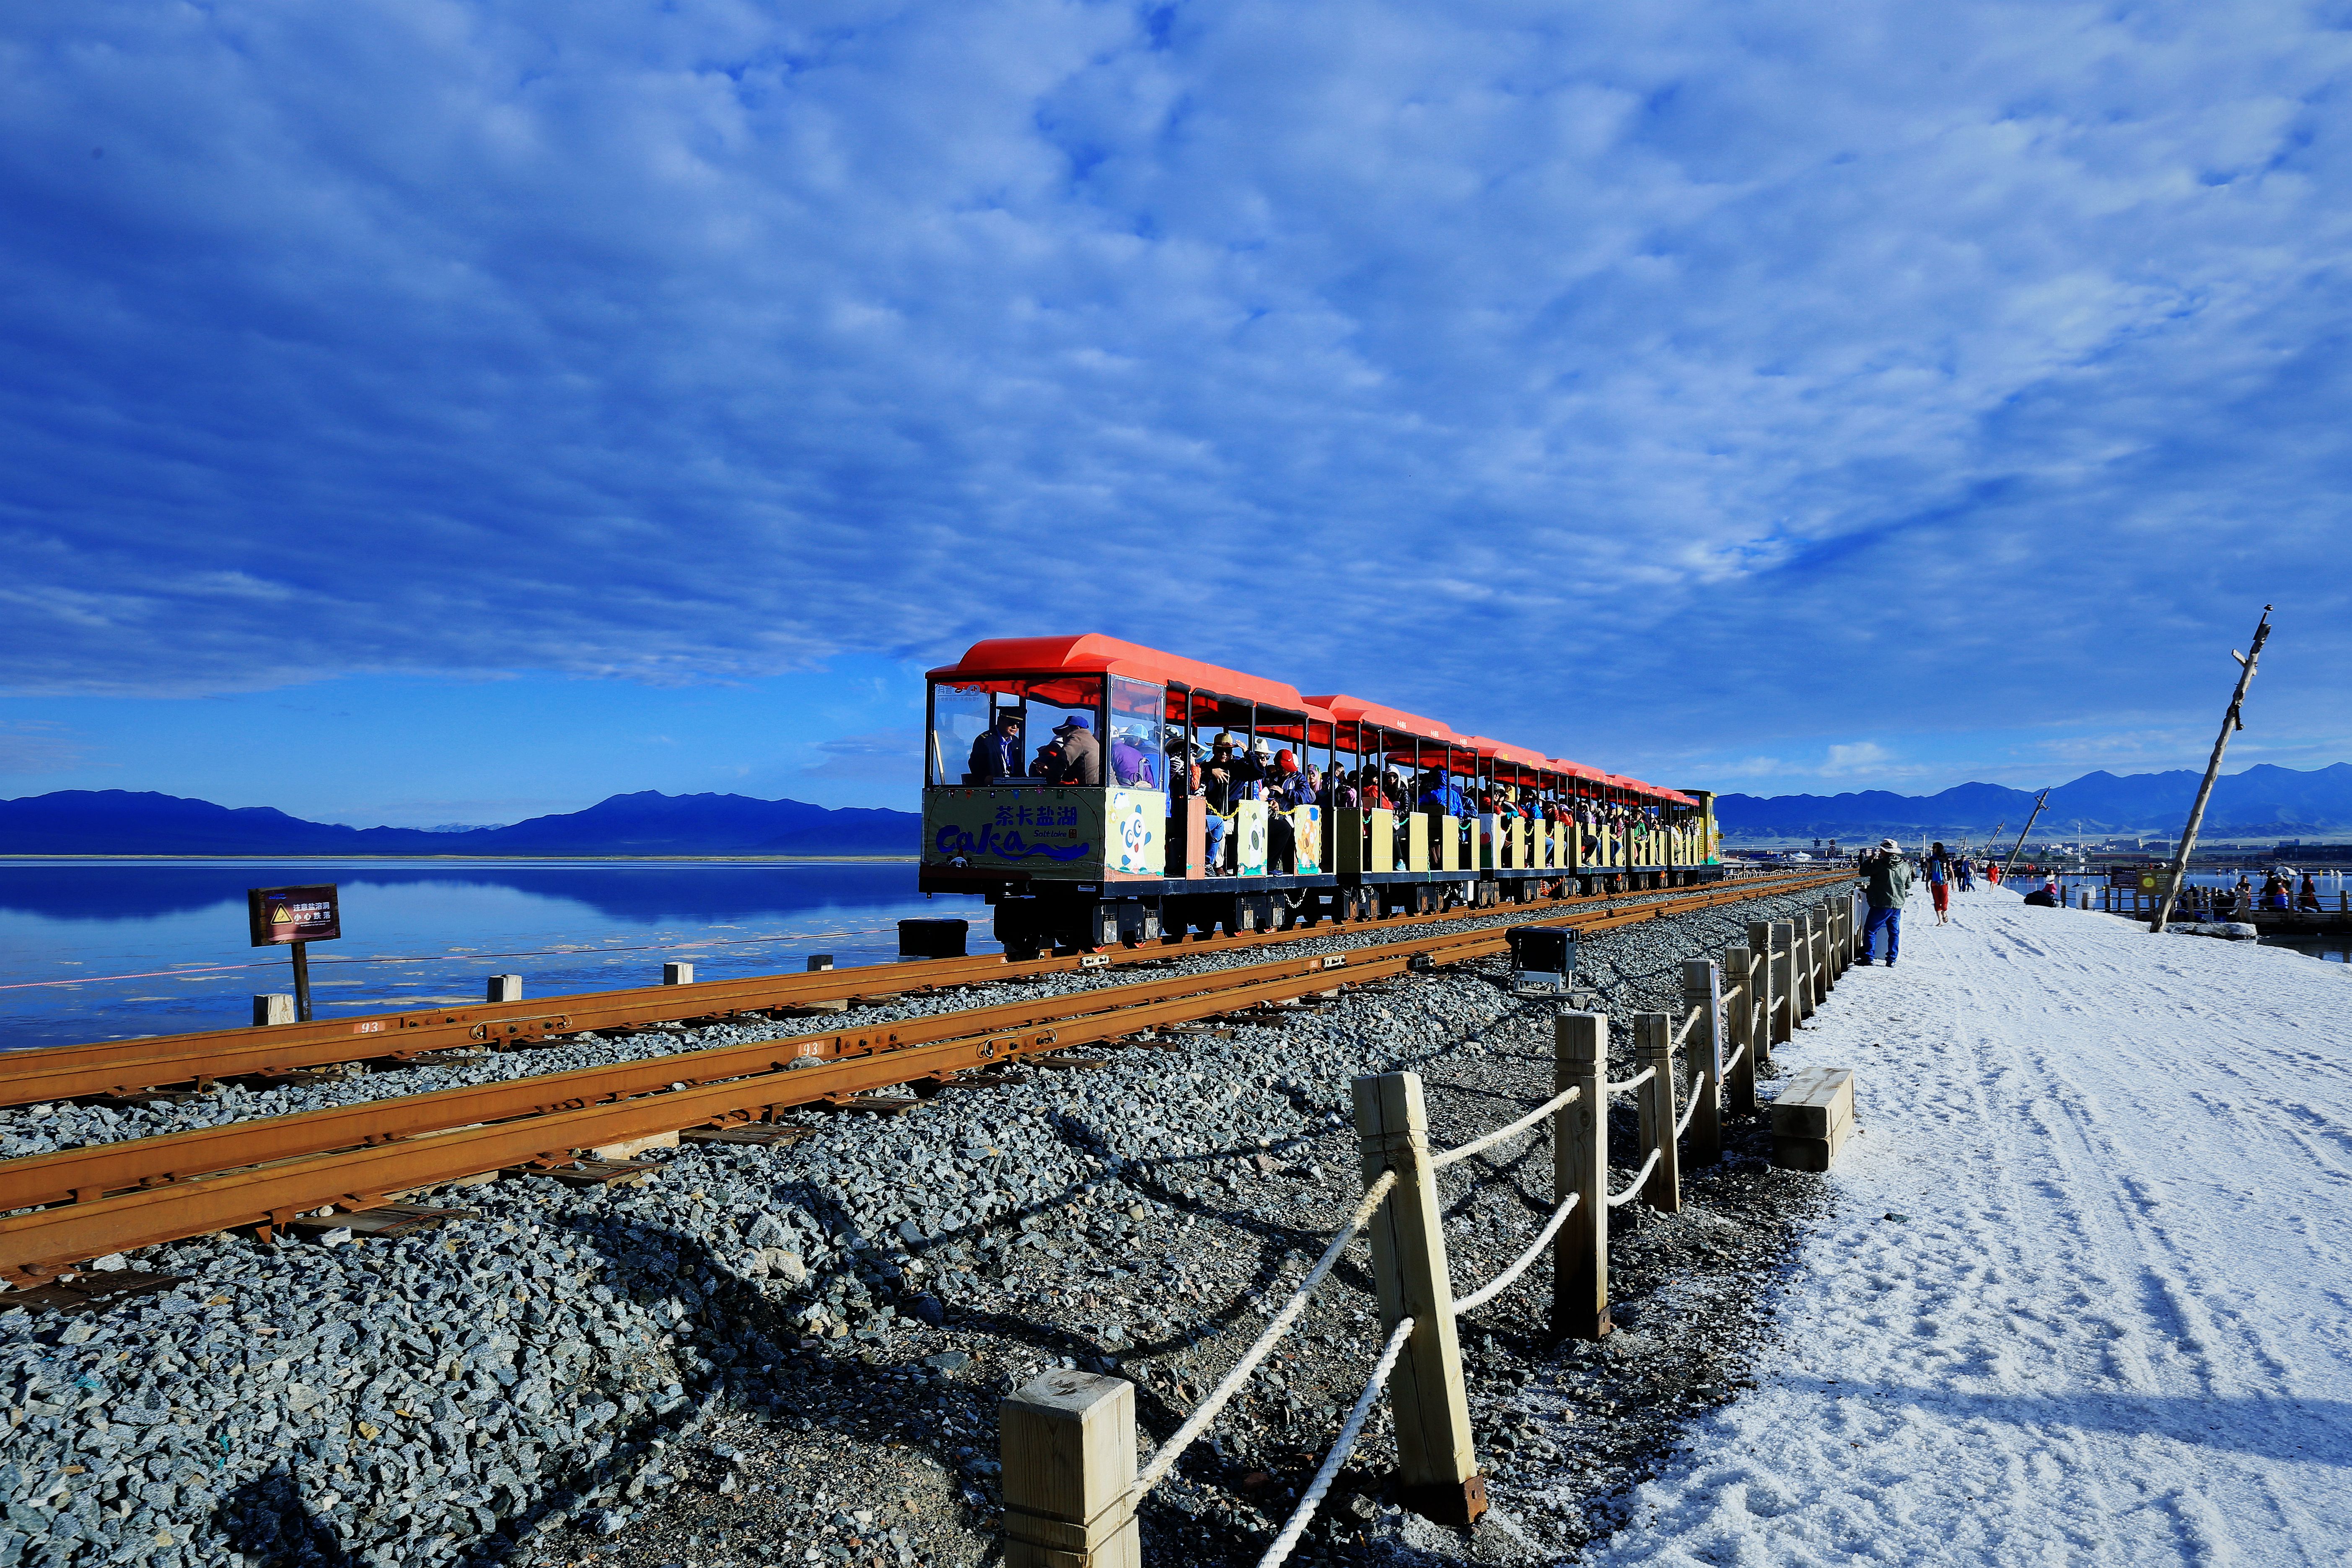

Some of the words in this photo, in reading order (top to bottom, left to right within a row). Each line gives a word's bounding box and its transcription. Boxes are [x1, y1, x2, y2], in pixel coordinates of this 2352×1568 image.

[995, 805, 1077, 826] 茶卡盐湖
[936, 823, 1028, 860] Caka
[361, 1022, 379, 1033] 93
[803, 1042, 819, 1056] 93
